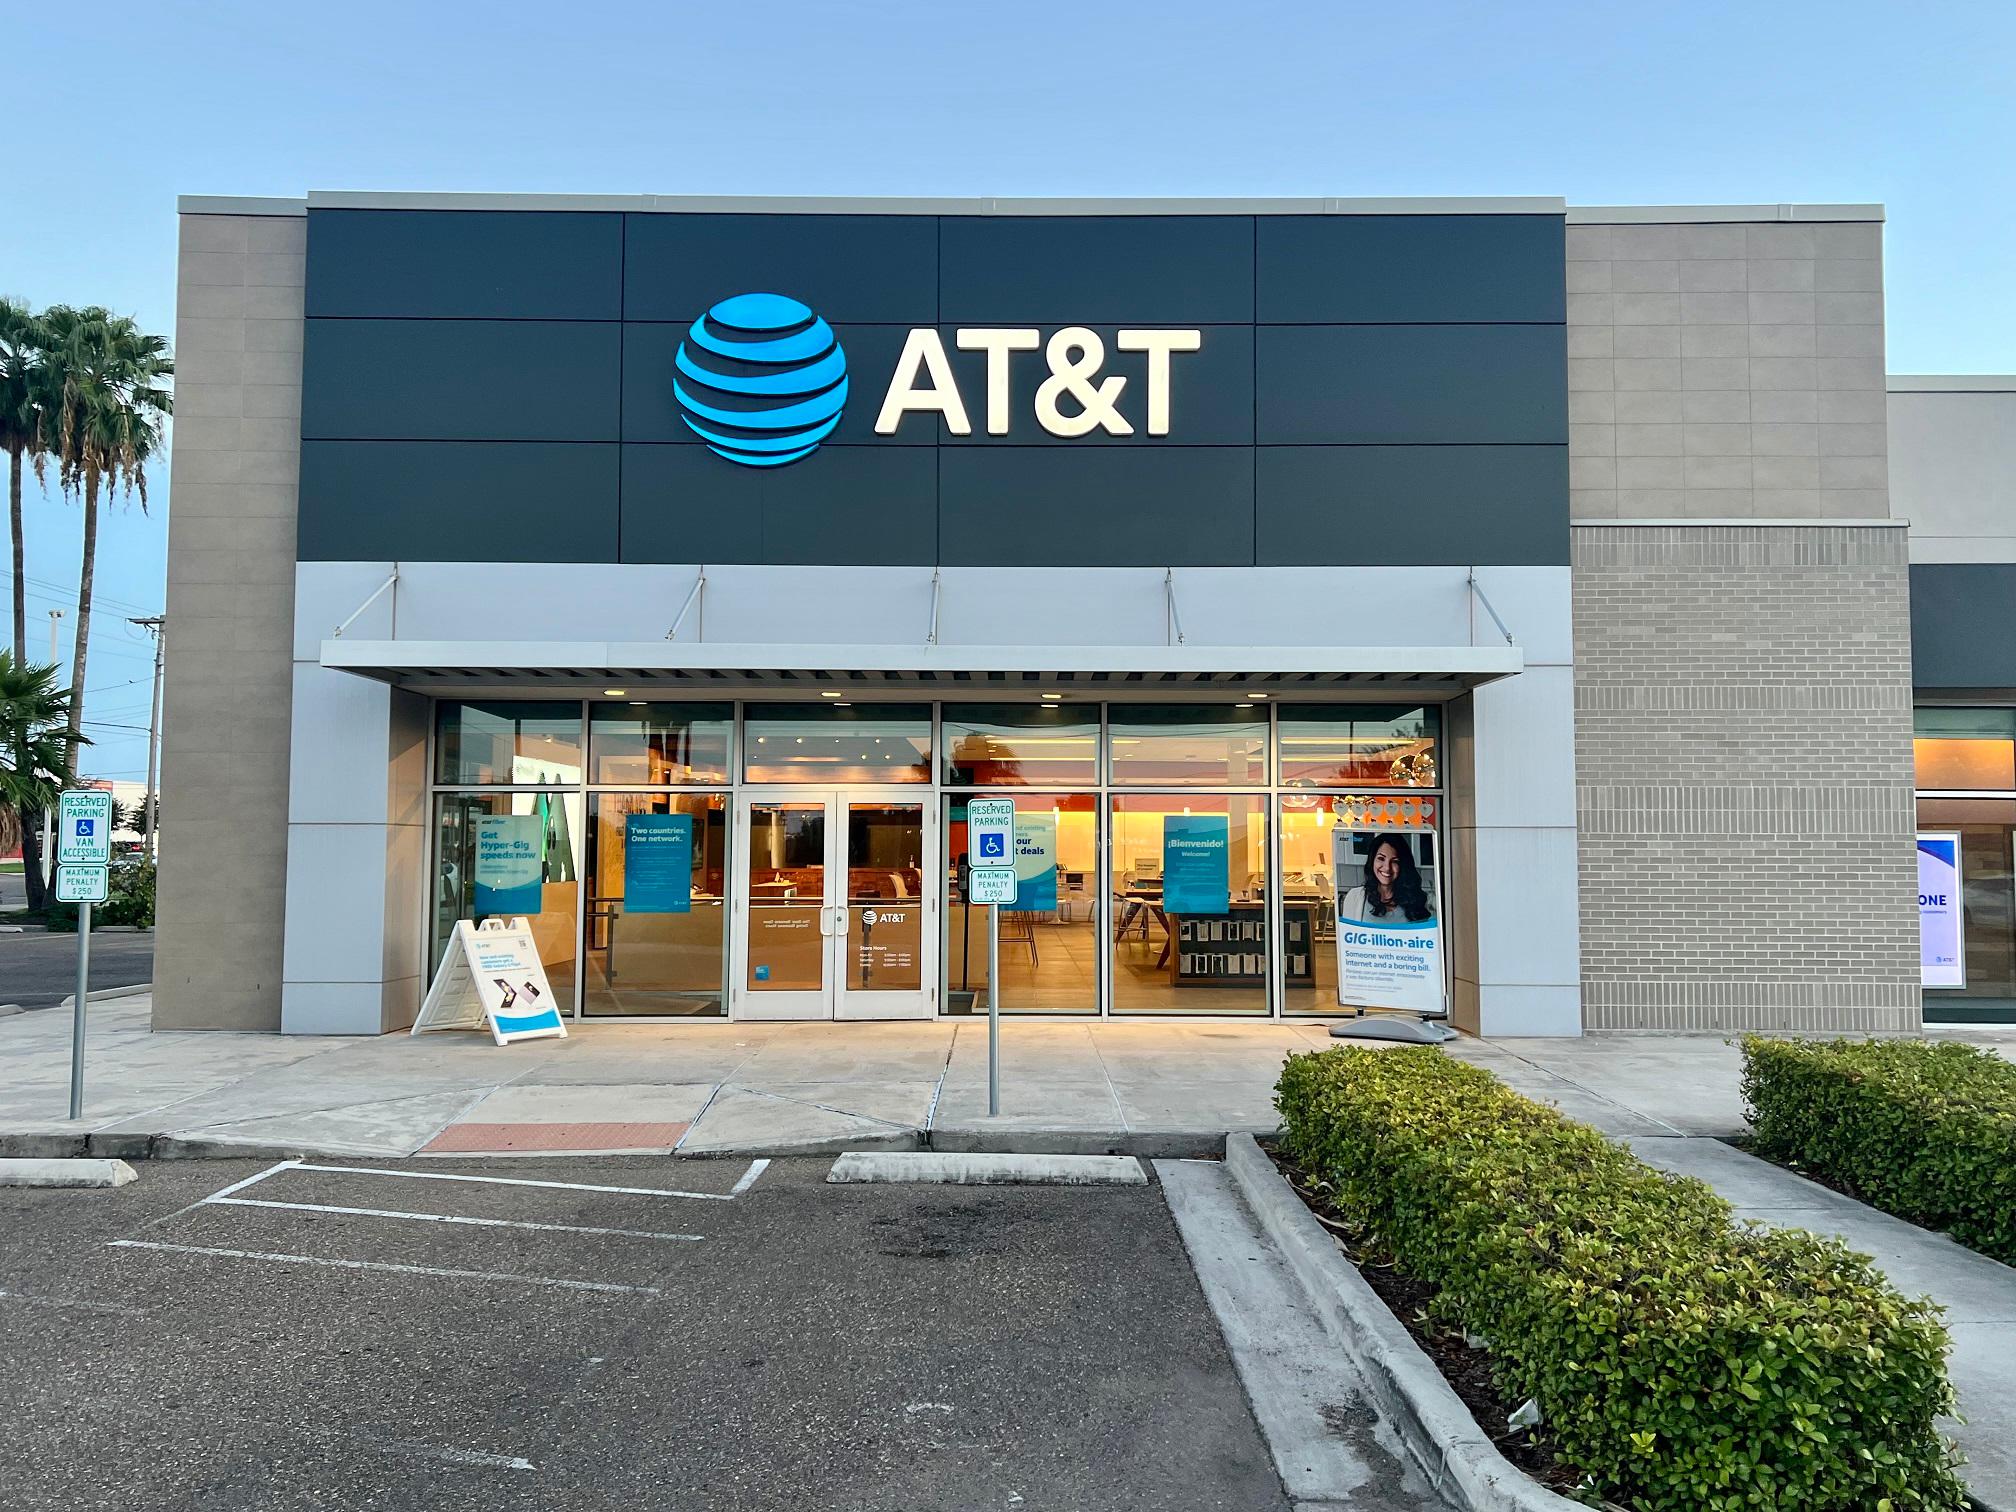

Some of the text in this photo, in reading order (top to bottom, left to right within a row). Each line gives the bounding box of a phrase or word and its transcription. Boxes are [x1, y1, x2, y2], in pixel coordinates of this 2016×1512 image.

[874, 326, 1201, 437] AT&T
[64, 797, 107, 807] RESERVED
[66, 808, 104, 818] PARKING
[972, 805, 1011, 815] RESERVED
[974, 817, 1009, 826] PARKING
[481, 831, 498, 840] Get
[76, 838, 94, 847] VAN
[480, 841, 530, 851] Hyper-Gig
[1168, 839, 1224, 849] ¡Bienvenido!
[62, 848, 106, 858] ACCESSIBLE
[480, 851, 514, 861] speeds
[1021, 847, 1044, 855] deals
[66, 868, 100, 876] MAXIMUM
[978, 881, 1008, 889] PENALTY
[72, 887, 92, 895] $250
[880, 913, 905, 922] AT&T
[1345, 951, 1424, 963] Someone with exciting
[1345, 958, 1372, 967] Internet
[1393, 964, 1417, 972] boring
[1417, 963, 1432, 971] bill.
